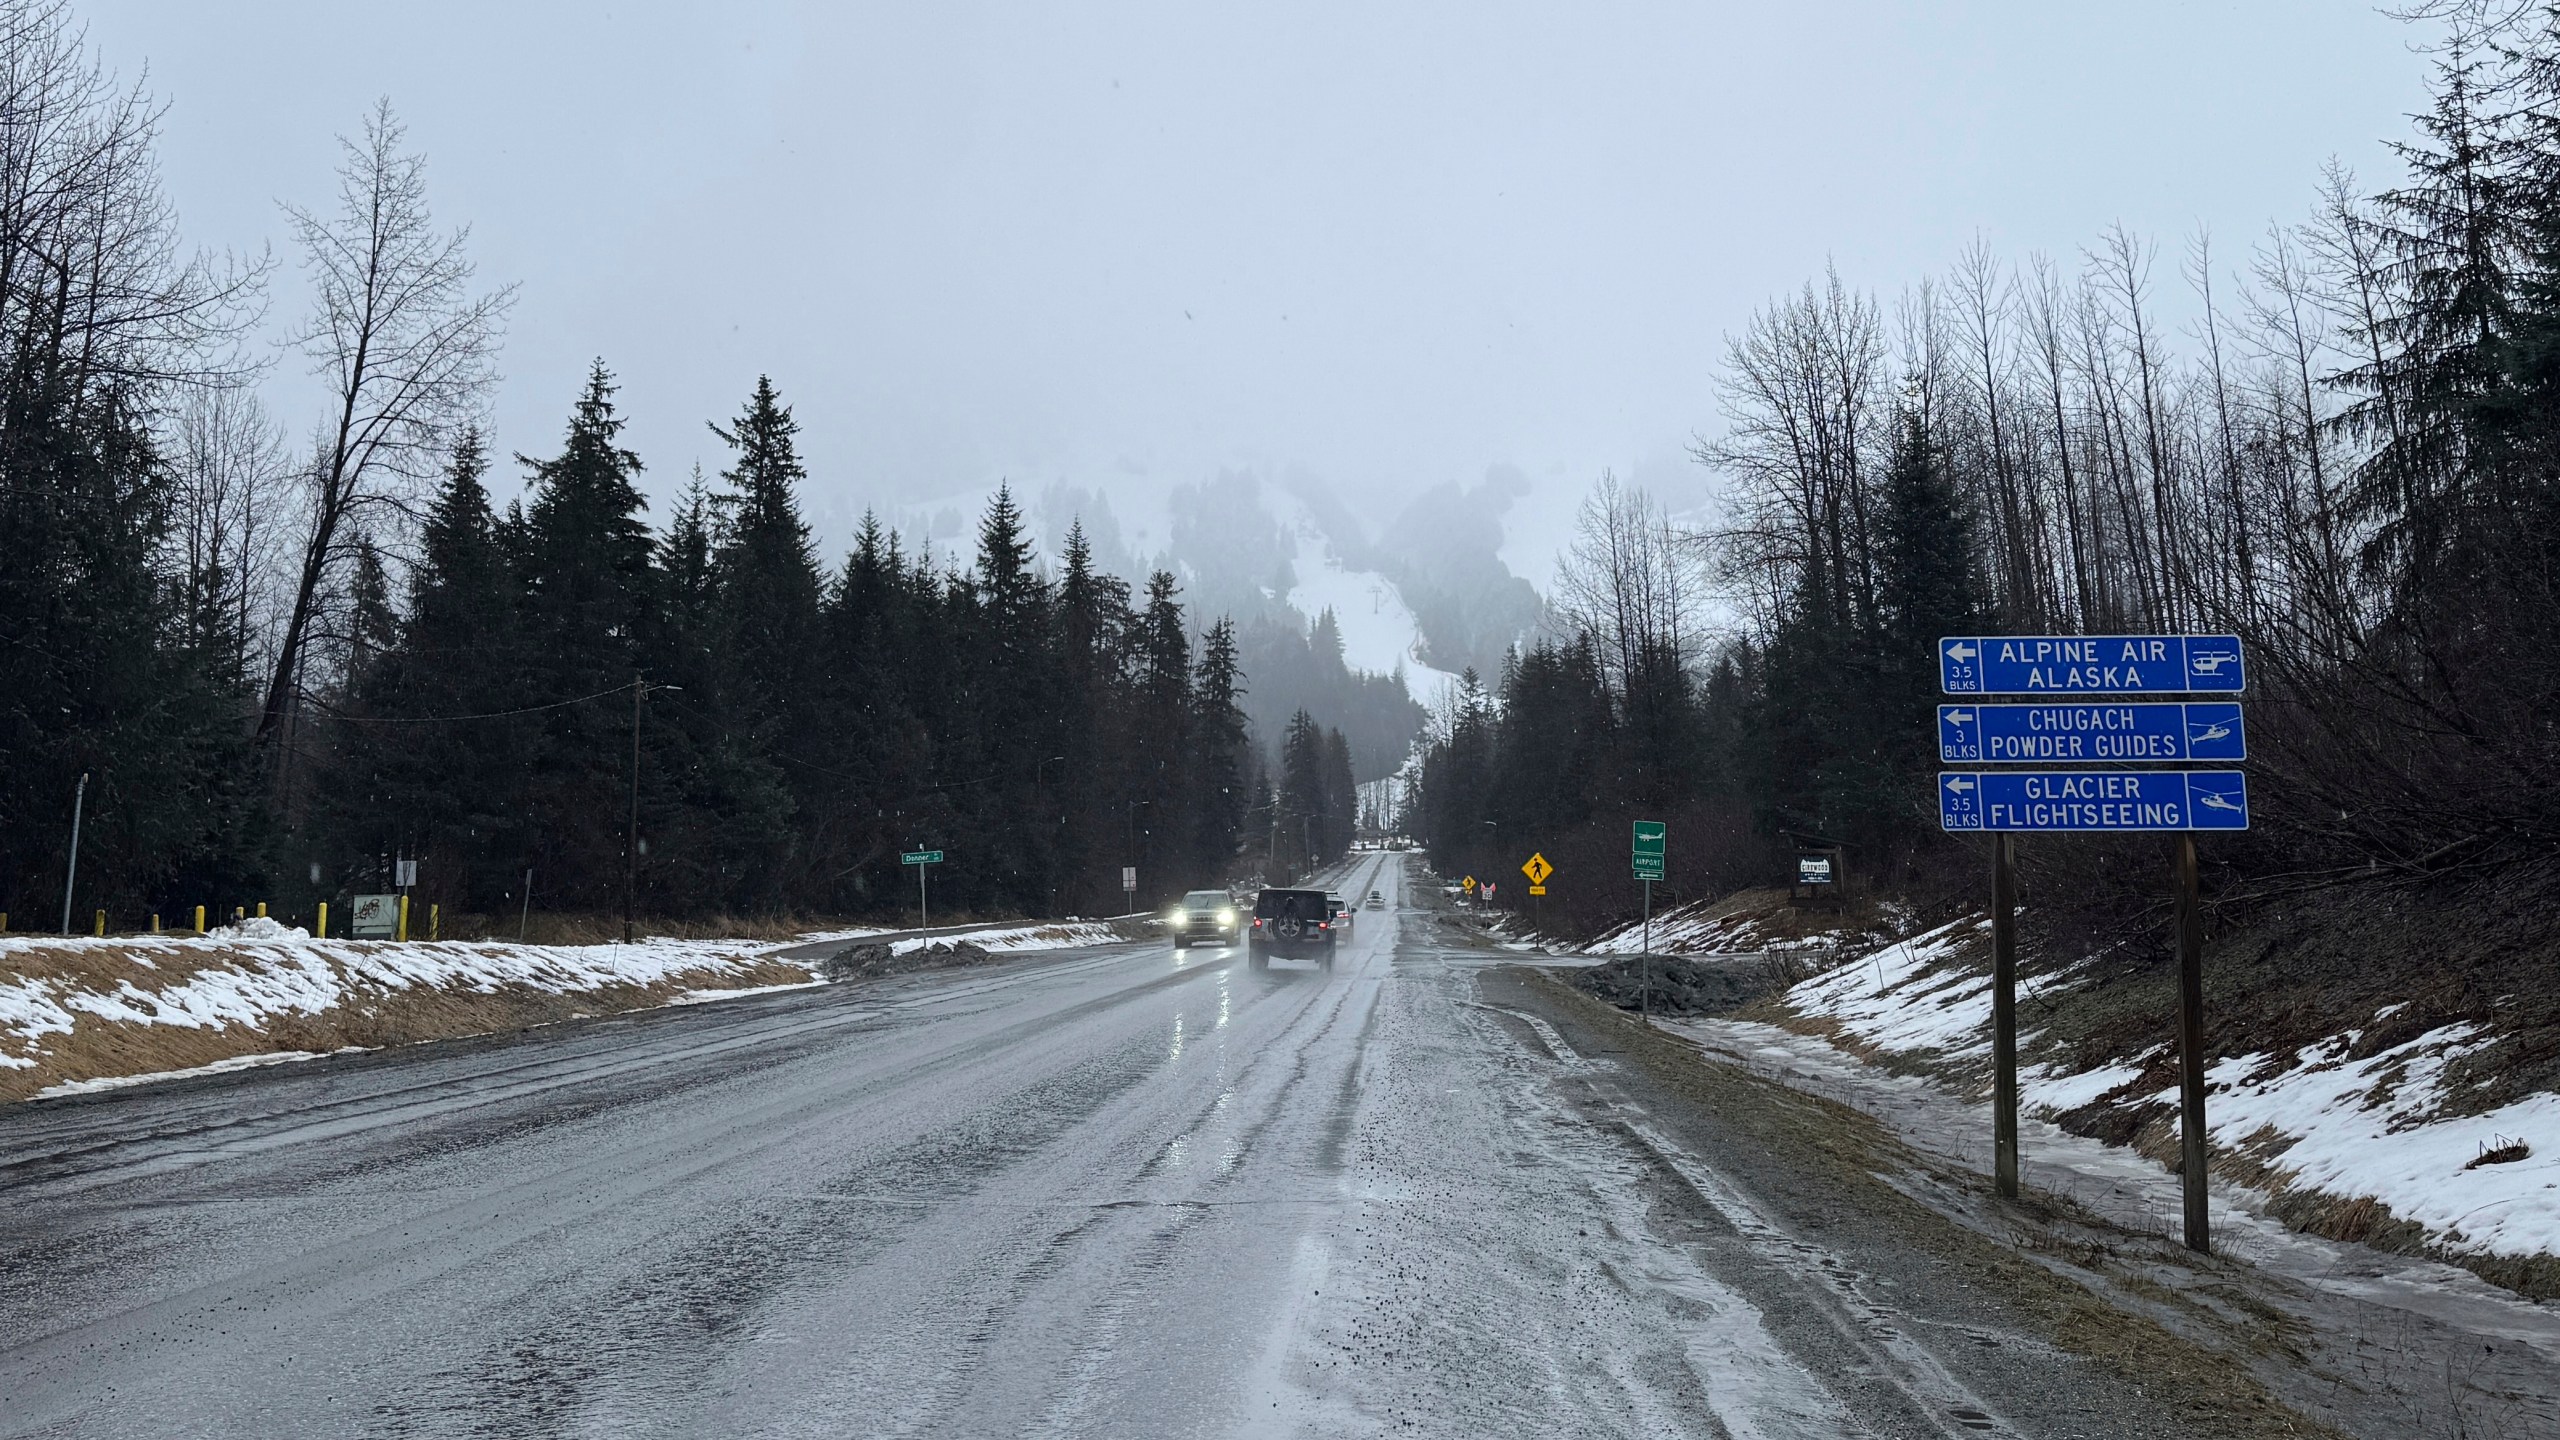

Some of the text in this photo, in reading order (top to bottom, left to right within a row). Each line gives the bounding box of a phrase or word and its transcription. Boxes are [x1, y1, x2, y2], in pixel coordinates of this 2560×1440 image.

[2000, 641, 2167, 663] ALPINE AIR
[1952, 666, 1972, 678] 3.5
[2028, 666, 2142, 688] ALASKA
[1950, 680, 1976, 690] BLKS
[2029, 709, 2135, 731] CHUGACH
[1956, 730, 1965, 743] 3
[1944, 745, 1977, 758] BLKS
[1991, 735, 2176, 757] POWDER GUIDES
[2025, 777, 2141, 799] GLACIER
[1951, 798, 1971, 811] 3.5
[1945, 813, 1979, 827] BLKS
[1991, 803, 2179, 826] FLIGHTSEEING
[1635, 858, 1661, 867] AIRPORT
